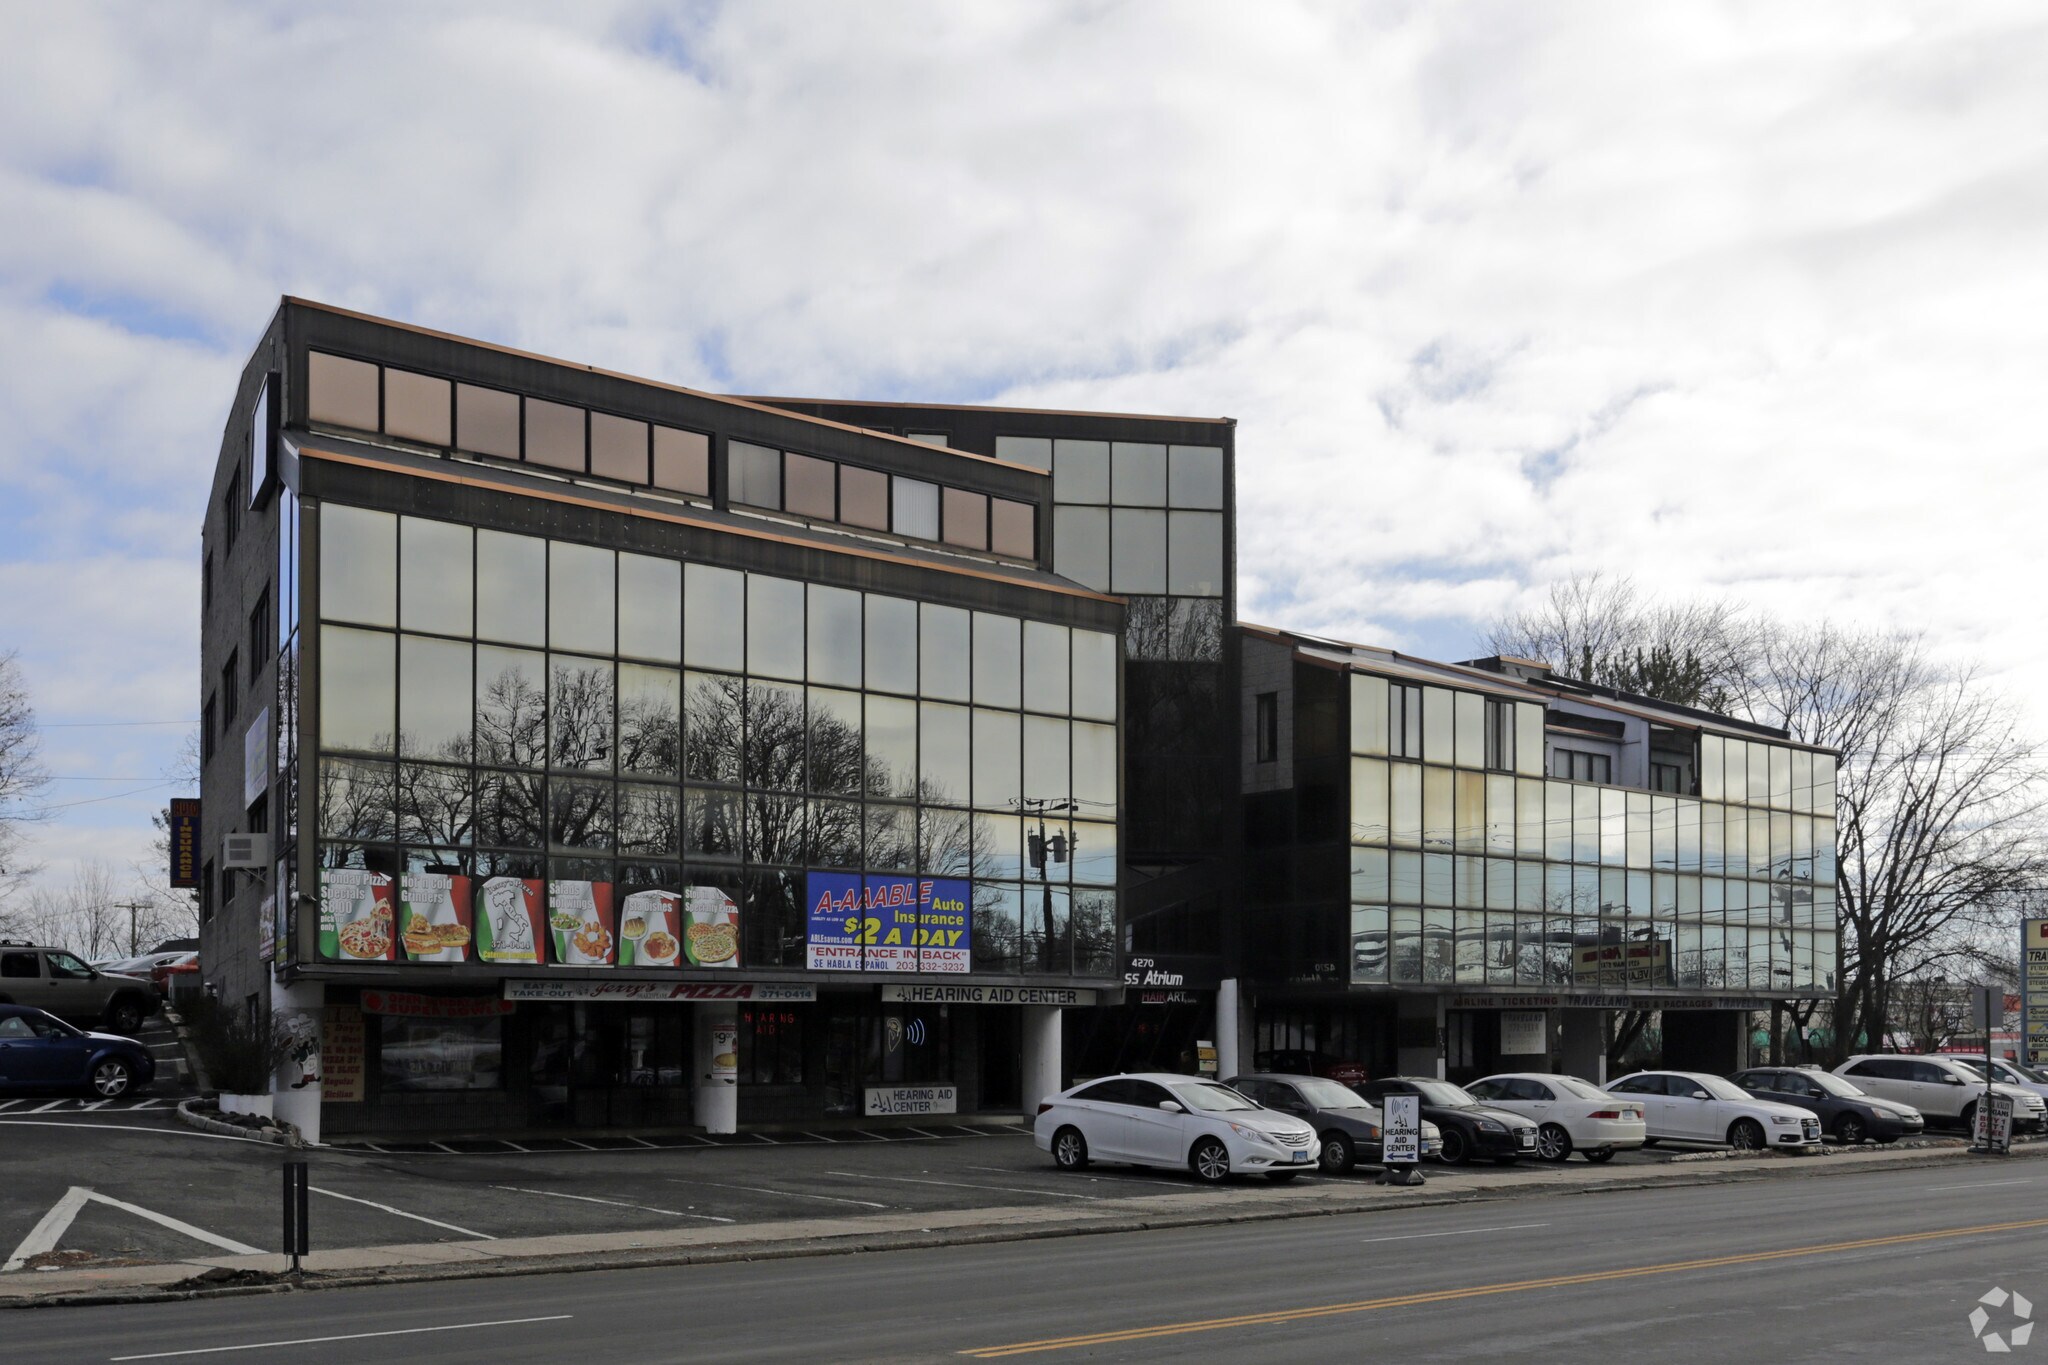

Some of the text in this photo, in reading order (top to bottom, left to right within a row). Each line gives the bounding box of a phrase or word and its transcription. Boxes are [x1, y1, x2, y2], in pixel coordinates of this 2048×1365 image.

[174, 801, 198, 816] AUTO
[179, 816, 193, 879] INSURANCE
[321, 871, 388, 886] Monday Pizza
[431, 878, 452, 890] Cold
[321, 886, 366, 900] Specials
[550, 883, 580, 896] Salads
[401, 890, 443, 904] Grinders
[814, 882, 934, 914] A-AAABLE
[321, 899, 352, 914] $8.00
[568, 898, 593, 911] wings
[644, 900, 673, 912] Dishes
[932, 898, 964, 911] Auto
[321, 915, 335, 923] pick
[321, 924, 335, 932] only
[883, 928, 902, 945] A
[910, 929, 964, 947] DAY
[902, 949, 917, 959] IN
[2029, 951, 2048, 961] TRA
[814, 959, 823, 968] SE
[827, 959, 852, 969] HABLA
[1131, 958, 1153, 968] 4270
[1141, 970, 1183, 986] Atrium
[512, 990, 574, 998] TAKE-OUT
[669, 984, 754, 999] PIZZA
[760, 990, 812, 998] 371-0414
[912, 988, 982, 1002] HEARING
[988, 989, 1013, 1003] AID
[1019, 990, 1076, 1004] CENTER
[1167, 992, 1186, 1002] ART
[1502, 996, 1558, 1006] TICKETING
[1567, 995, 1629, 1008] TRAVELAND
[1664, 1000, 1713, 1009] PACKAGES
[894, 1089, 953, 1101] HEARING AID
[894, 1102, 931, 1112] CENTER
[1385, 1128, 1418, 1136] HEARING
